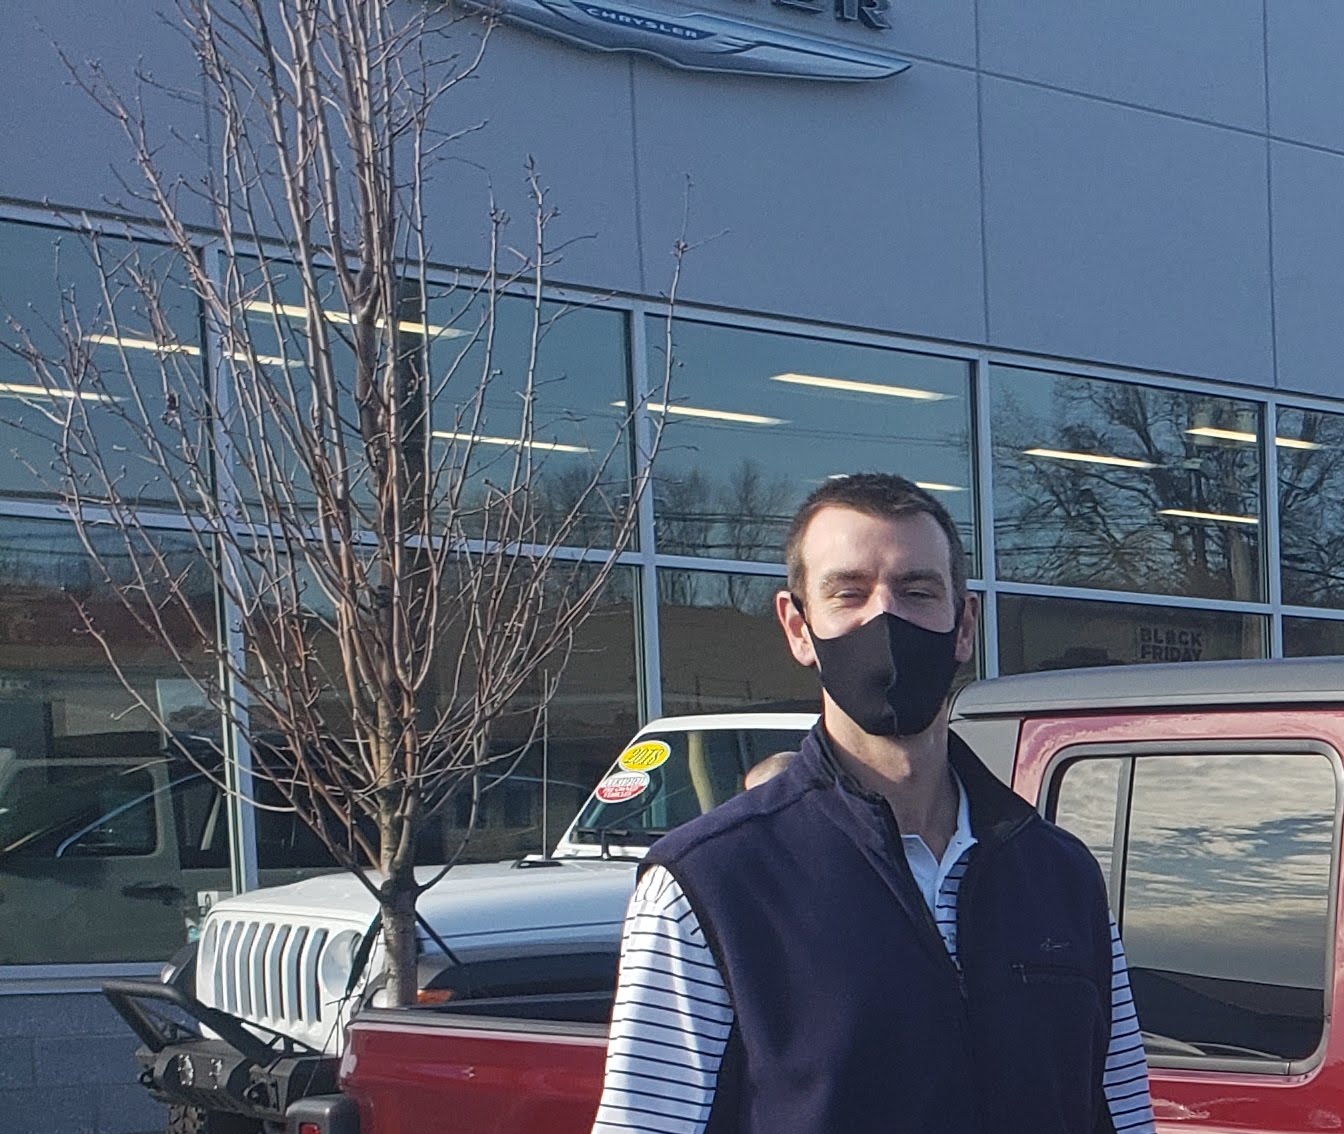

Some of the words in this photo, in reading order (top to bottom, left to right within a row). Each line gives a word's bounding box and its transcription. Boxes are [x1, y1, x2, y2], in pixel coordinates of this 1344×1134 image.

[587, 7, 697, 39] CHRYSLER
[1141, 627, 1202, 648] BLACK
[1141, 644, 1202, 662] FRIDAY
